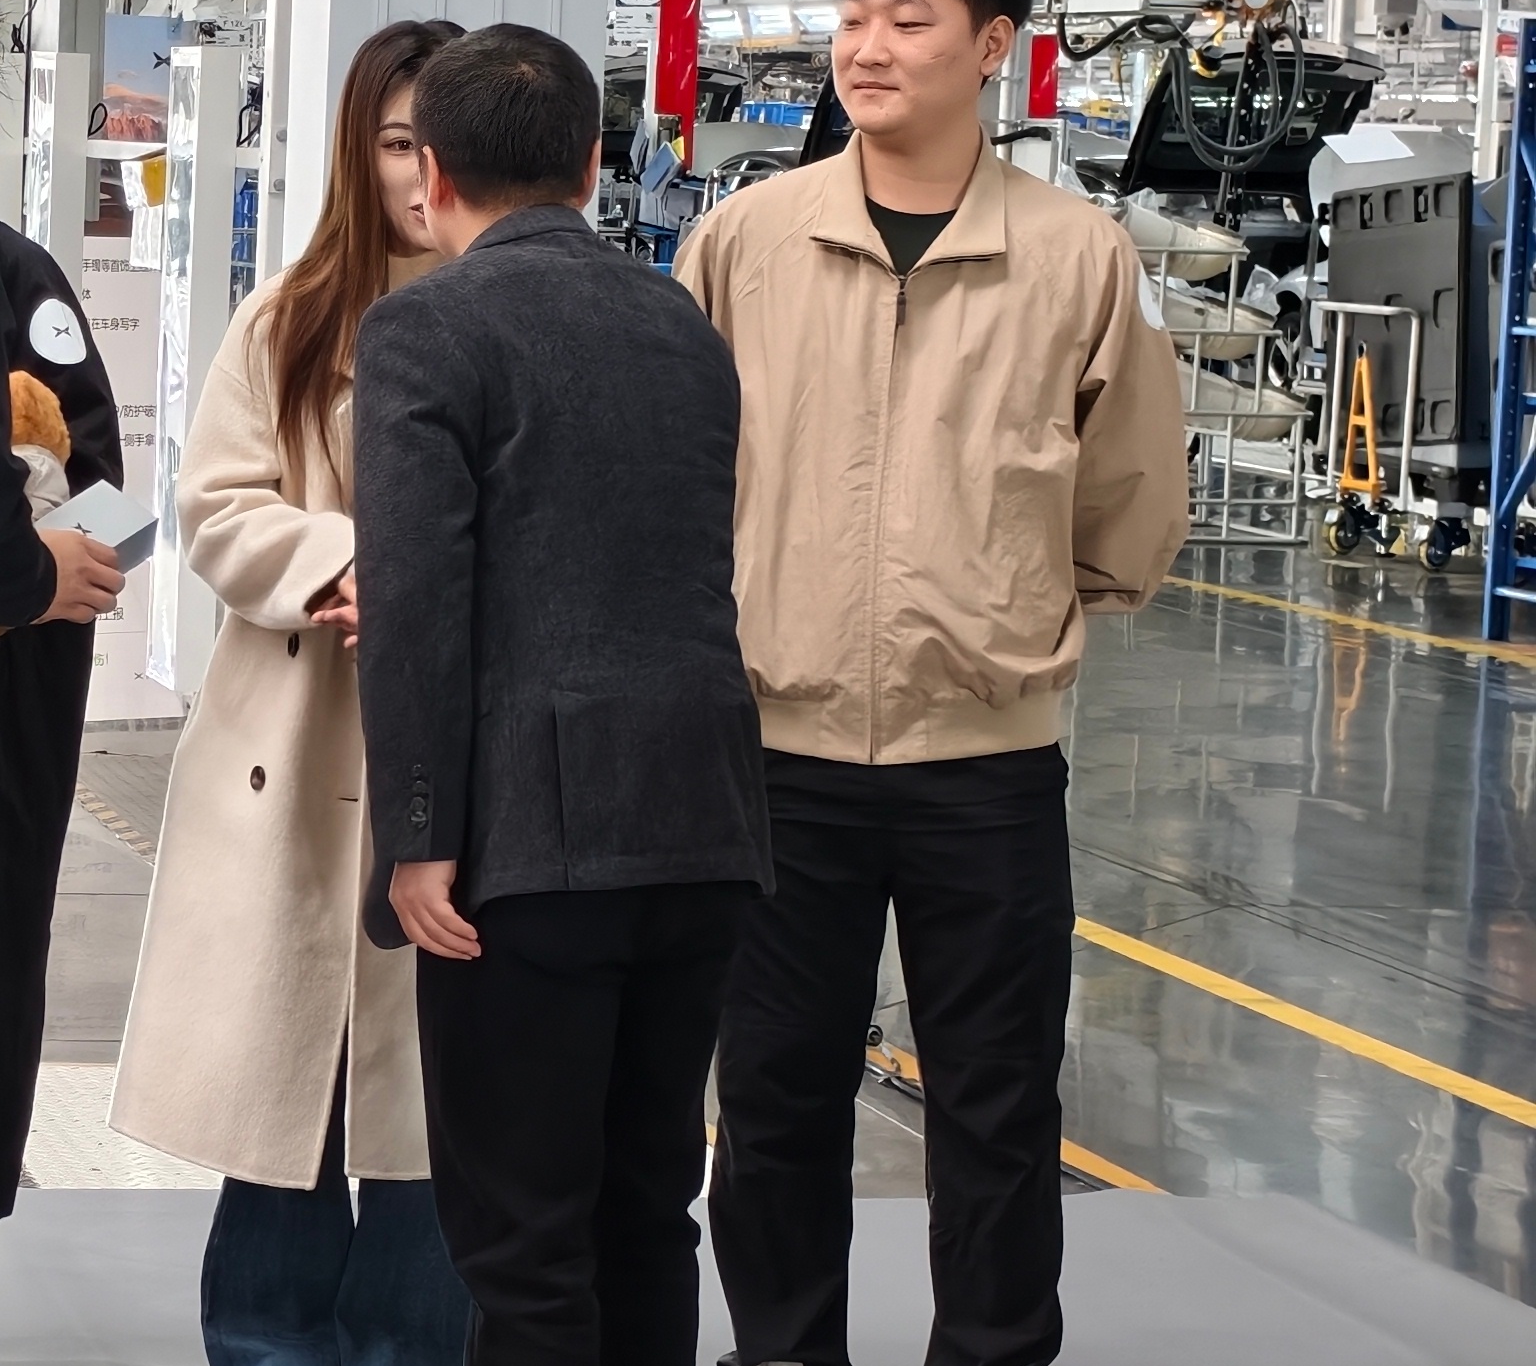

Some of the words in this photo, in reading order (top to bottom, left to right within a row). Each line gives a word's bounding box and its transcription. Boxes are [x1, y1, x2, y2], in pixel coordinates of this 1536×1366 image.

[87, 317, 140, 332] 在车身写字
